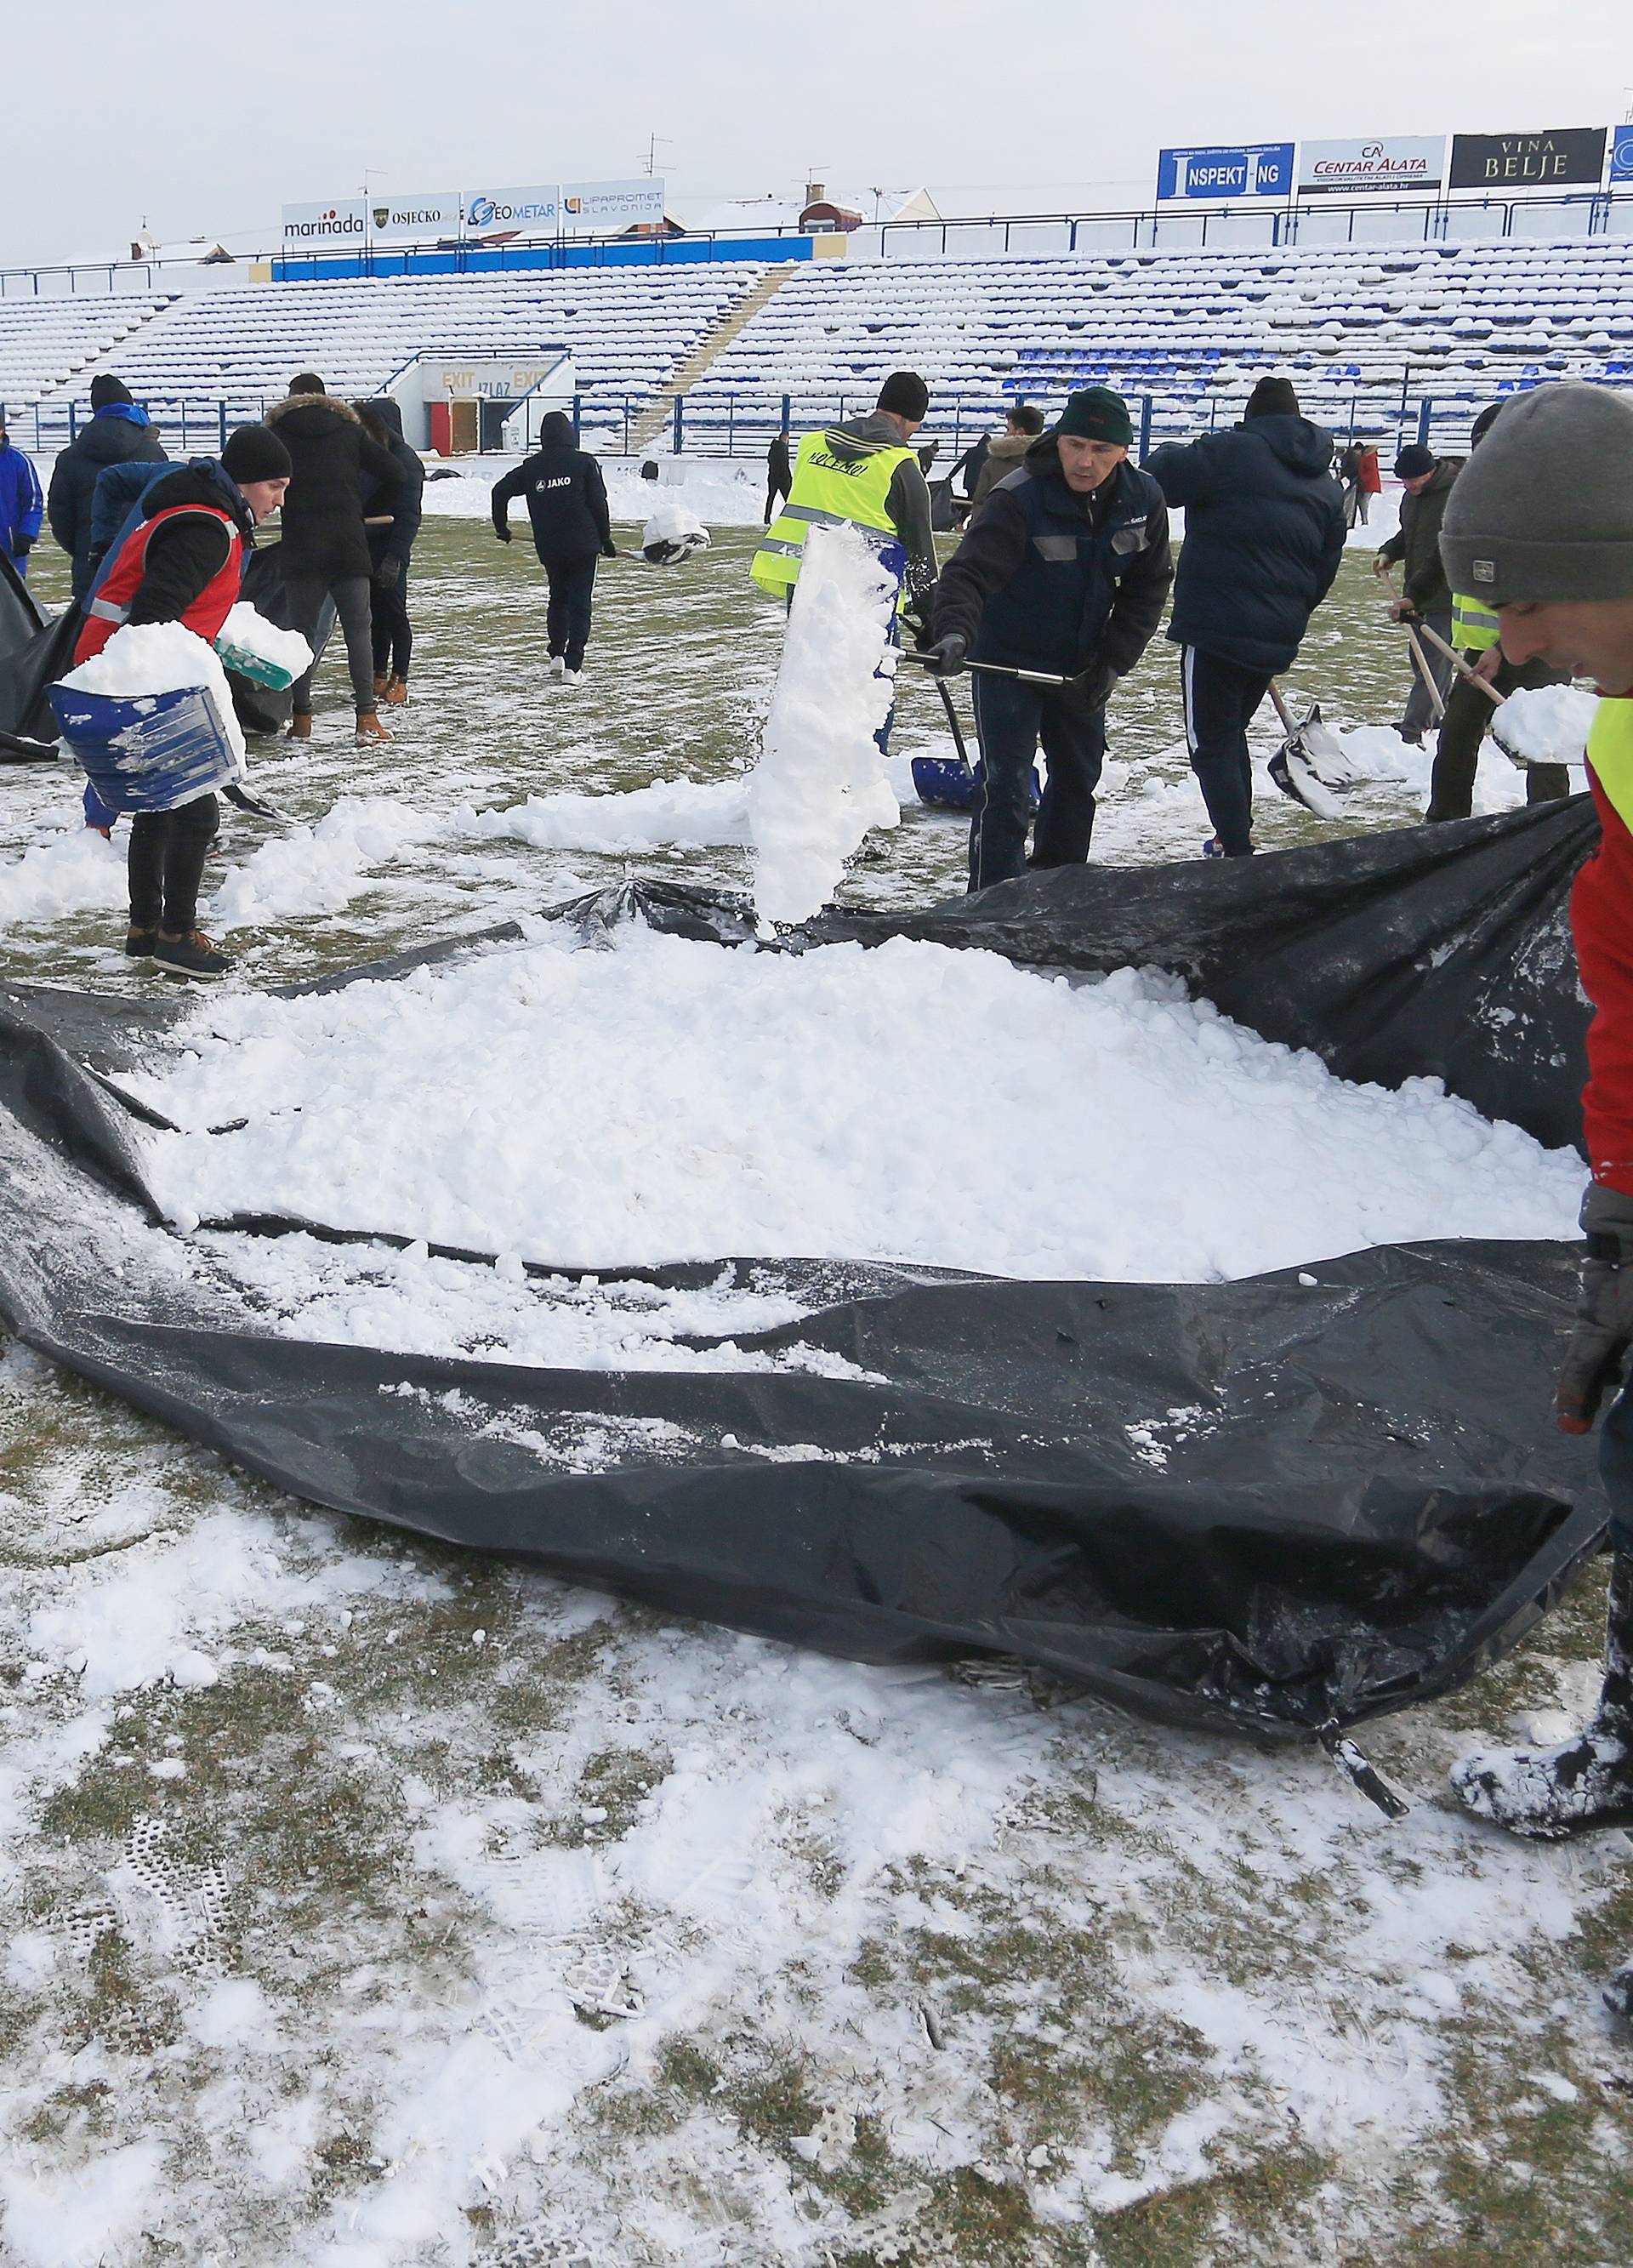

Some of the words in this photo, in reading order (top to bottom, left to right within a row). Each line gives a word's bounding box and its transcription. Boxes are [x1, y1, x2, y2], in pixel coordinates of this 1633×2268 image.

[1501, 140, 1555, 153] VINA
[1314, 160, 1374, 174] CENTAR
[1377, 157, 1427, 172] ALATA
[1484, 154, 1568, 180] BELJE
[1328, 181, 1409, 193] www.centar-alata.hr
[582, 191, 663, 205] LIPAPROMET
[583, 202, 662, 214] SLAVONIJA
[285, 212, 363, 237] marinada
[442, 372, 475, 389] EXIT
[479, 382, 510, 398] IZLAZ
[547, 476, 572, 489] JAKO
